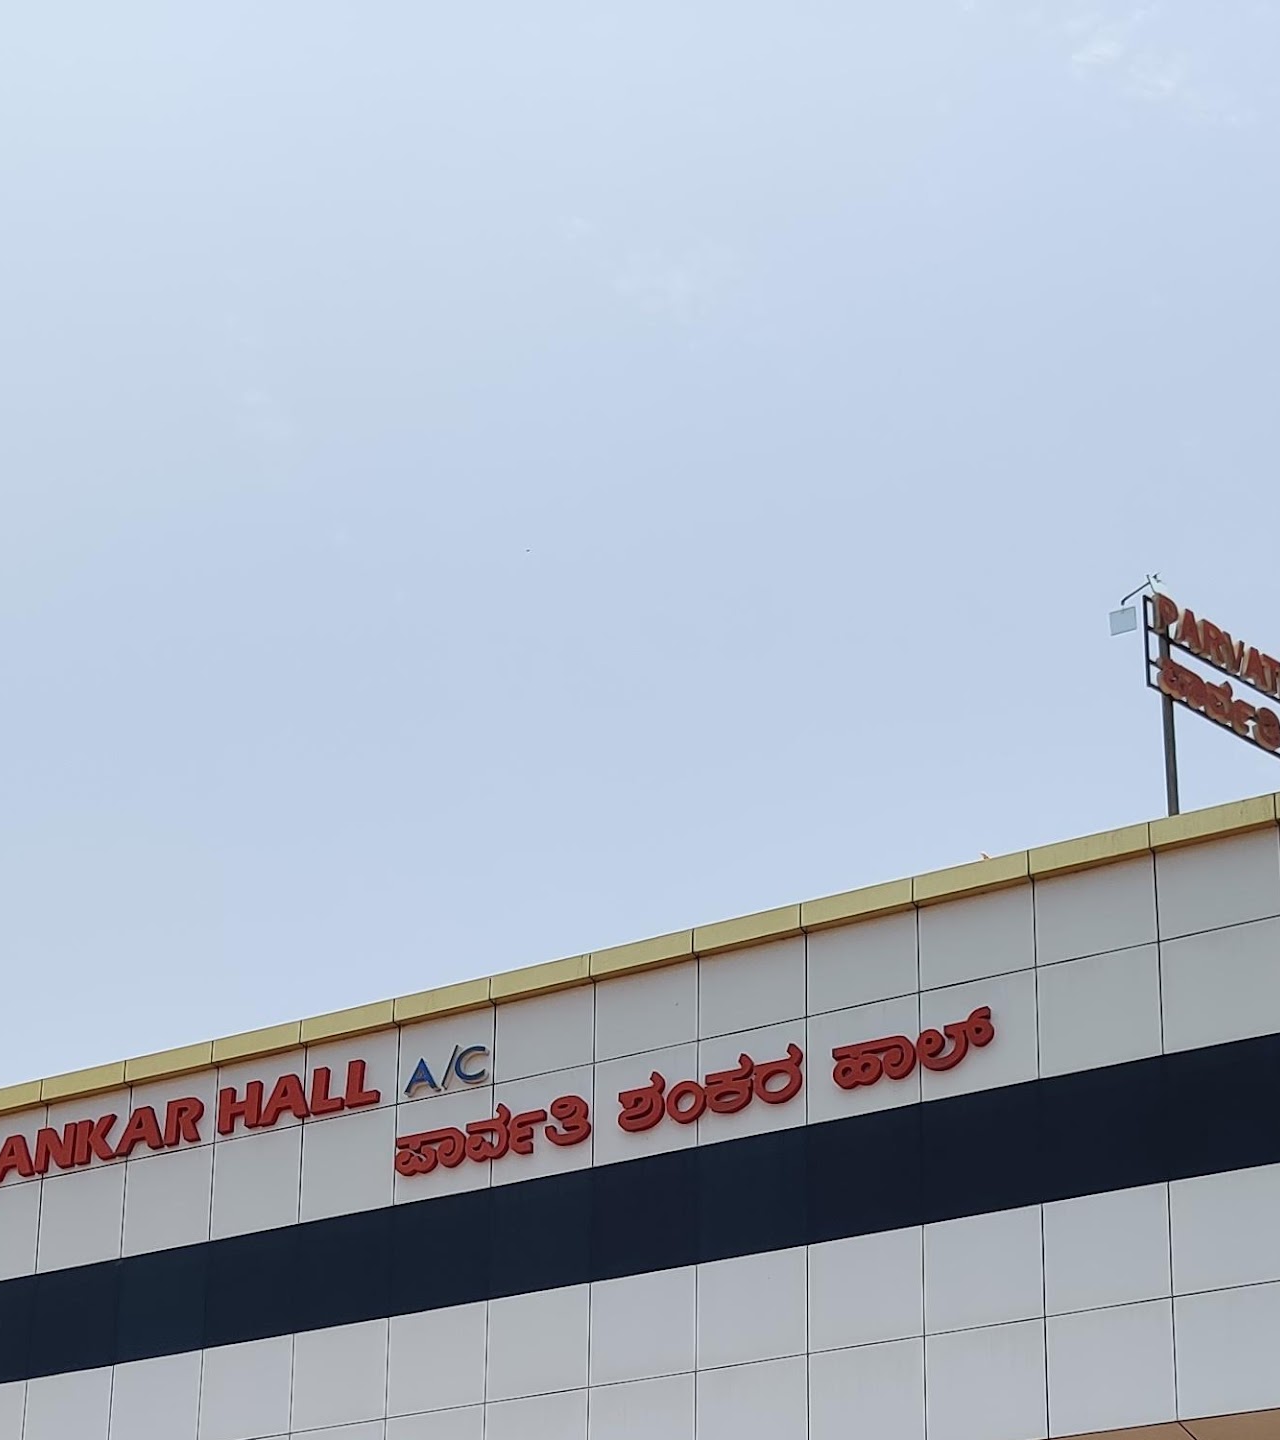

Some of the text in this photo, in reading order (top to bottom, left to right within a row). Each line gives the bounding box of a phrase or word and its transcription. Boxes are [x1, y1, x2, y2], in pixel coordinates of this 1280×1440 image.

[217, 1059, 380, 1135] HALL
[404, 1043, 490, 1096] A/C
[394, 1006, 995, 1177] ಪಾರ್ವತಿ ಶಂಕರ ಹಾಲ್
